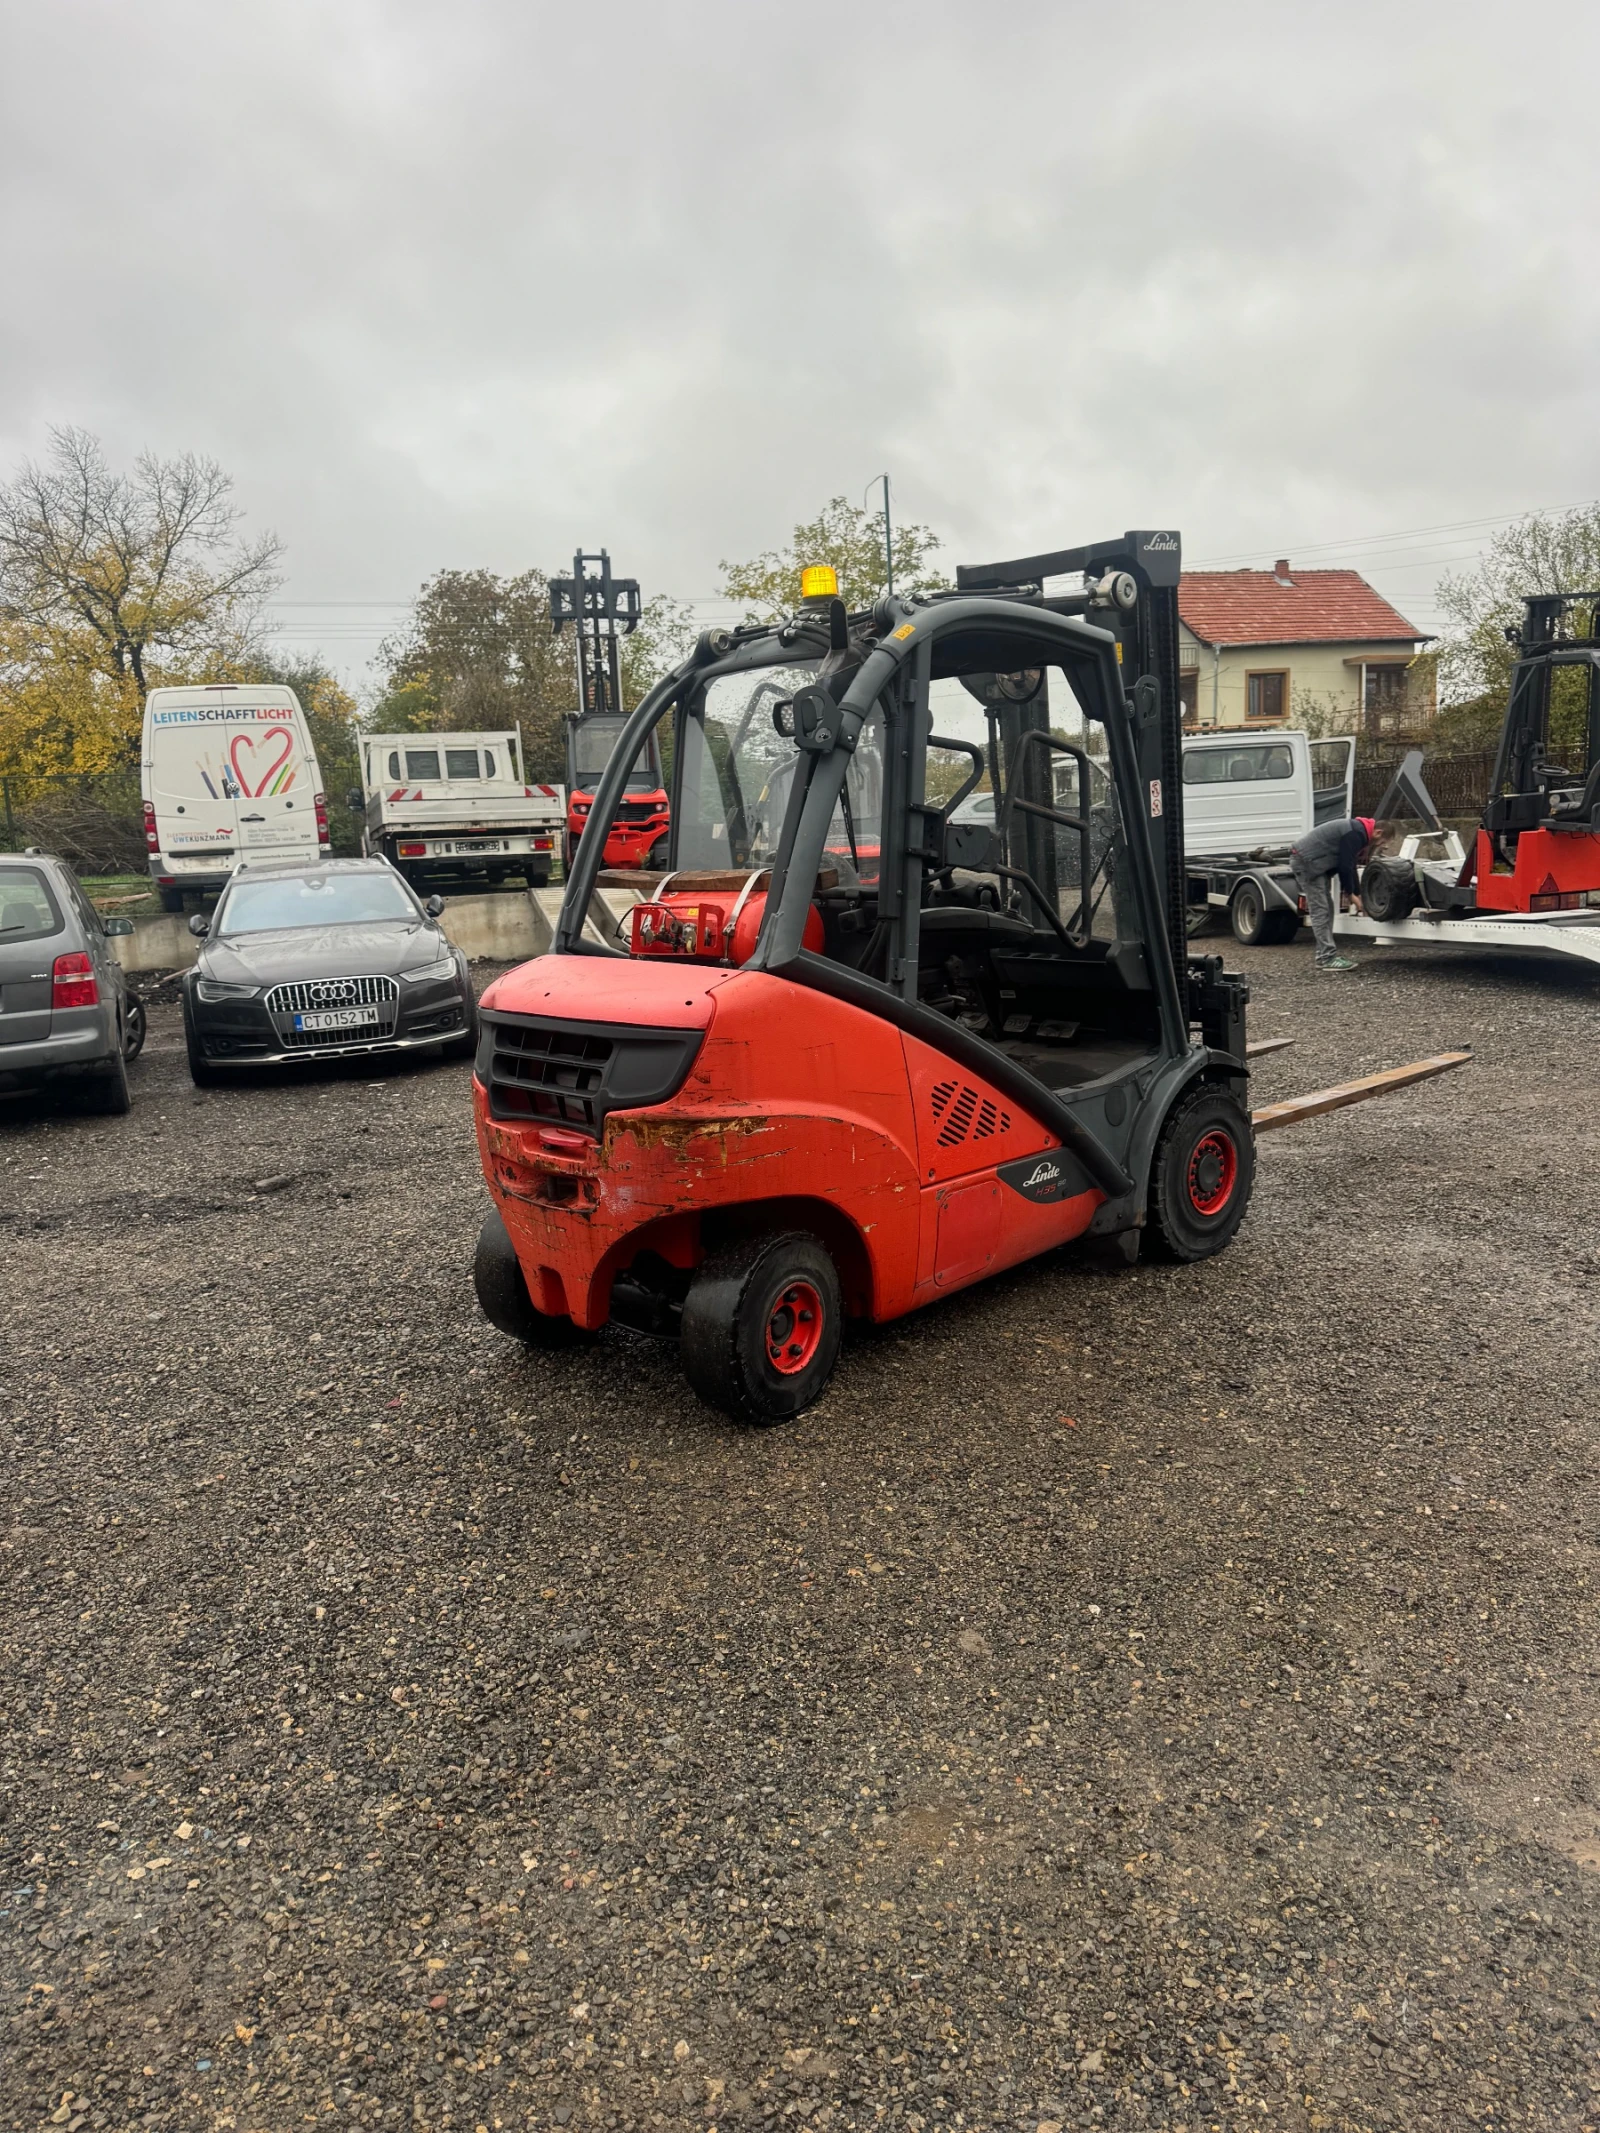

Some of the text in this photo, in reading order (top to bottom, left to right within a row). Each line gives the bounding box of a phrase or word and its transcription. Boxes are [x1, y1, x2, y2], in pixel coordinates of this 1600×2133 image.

[1143, 531, 1179, 551] Linde
[153, 708, 294, 724] LEITENSCHAFFTLICHT
[173, 834, 231, 843] UWEKUNZMANN
[304, 1015, 321, 1029] CT
[324, 1011, 357, 1026] 0152
[358, 1009, 376, 1022] TM
[1022, 1161, 1060, 1187] Linde
